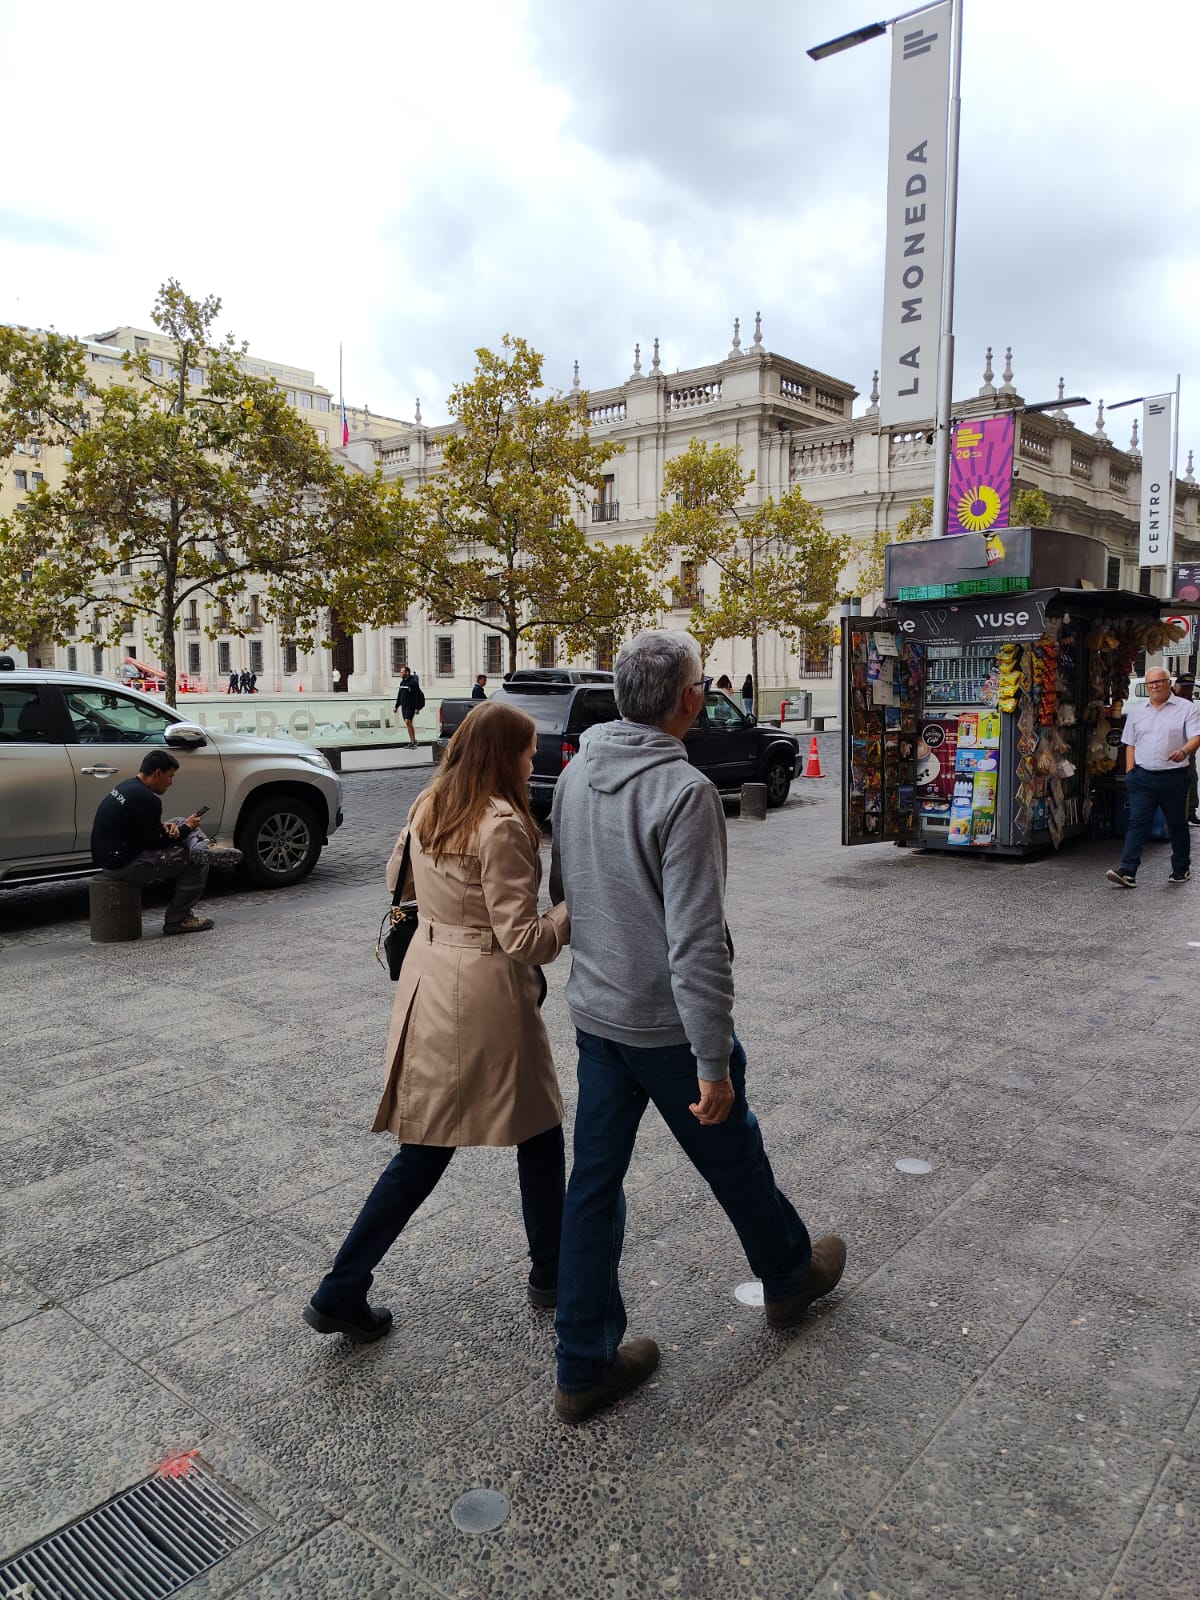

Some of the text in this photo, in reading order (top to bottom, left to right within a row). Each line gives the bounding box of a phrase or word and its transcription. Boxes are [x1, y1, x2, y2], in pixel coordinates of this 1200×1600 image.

[897, 139, 928, 397] LA MONEDA
[1149, 482, 1161, 554] CENTRO
